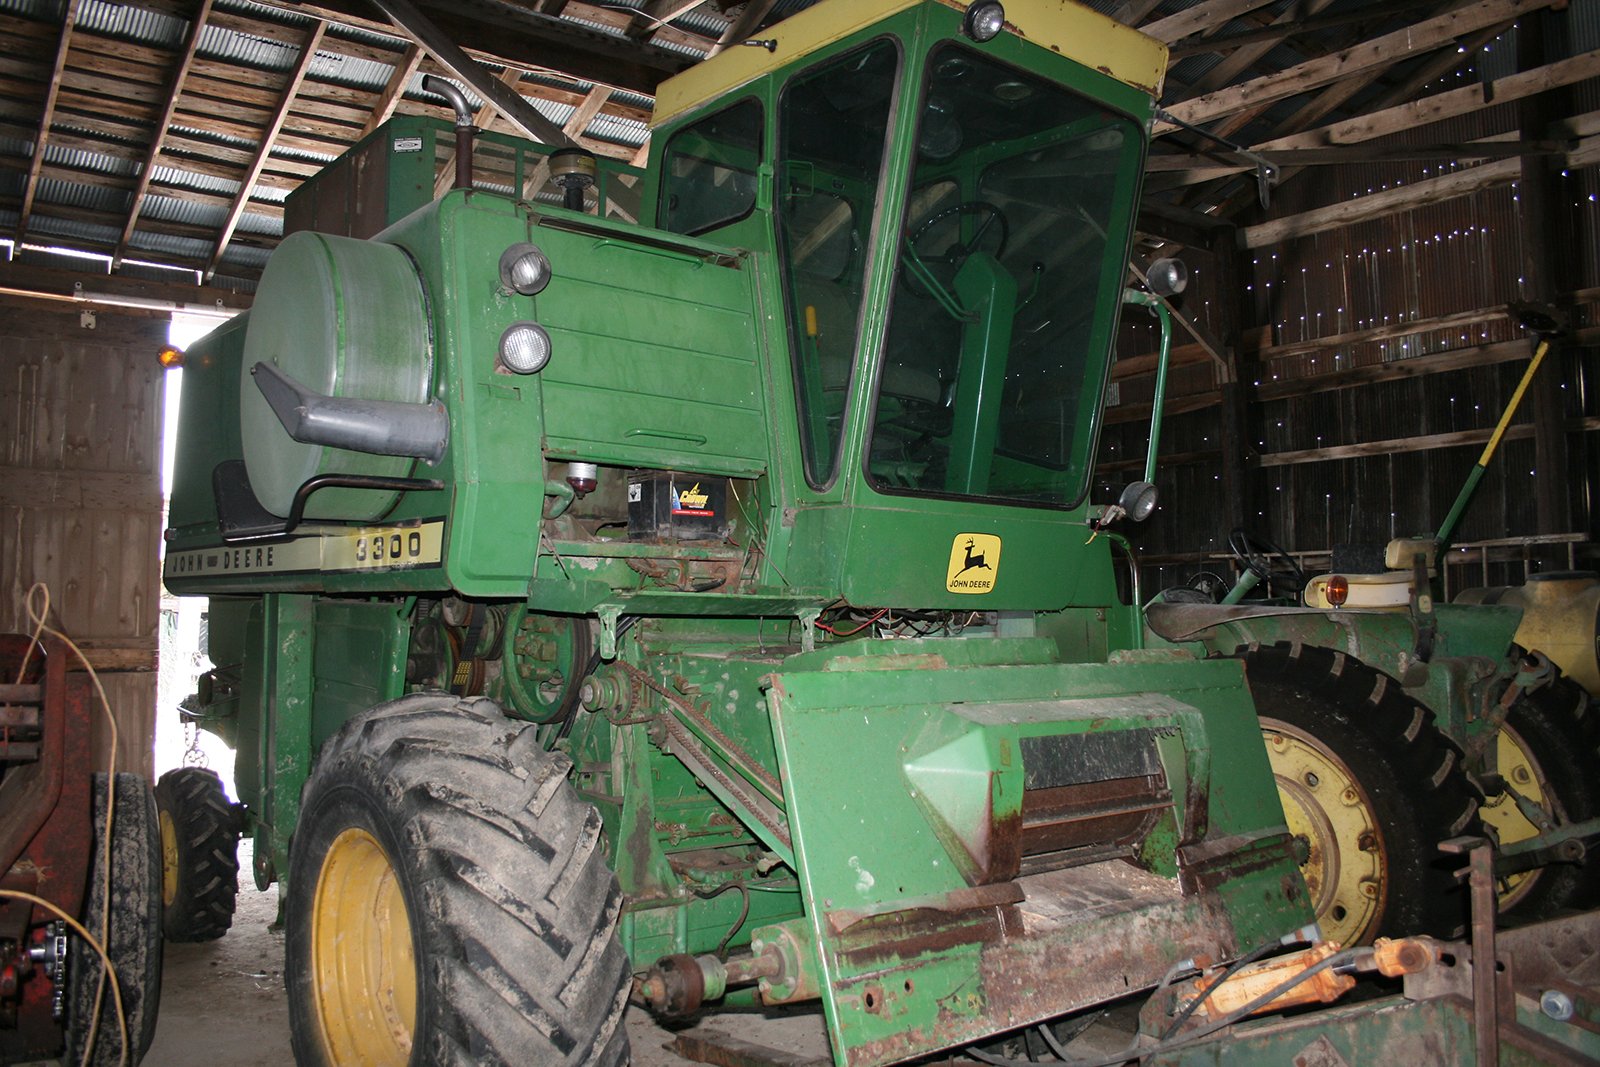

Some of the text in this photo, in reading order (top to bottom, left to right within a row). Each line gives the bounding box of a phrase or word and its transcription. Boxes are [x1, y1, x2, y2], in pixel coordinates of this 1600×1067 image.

[173, 546, 274, 572] JOHN DEERE
[356, 532, 421, 561] 3300
[950, 580, 991, 589] JOHN DEERE
